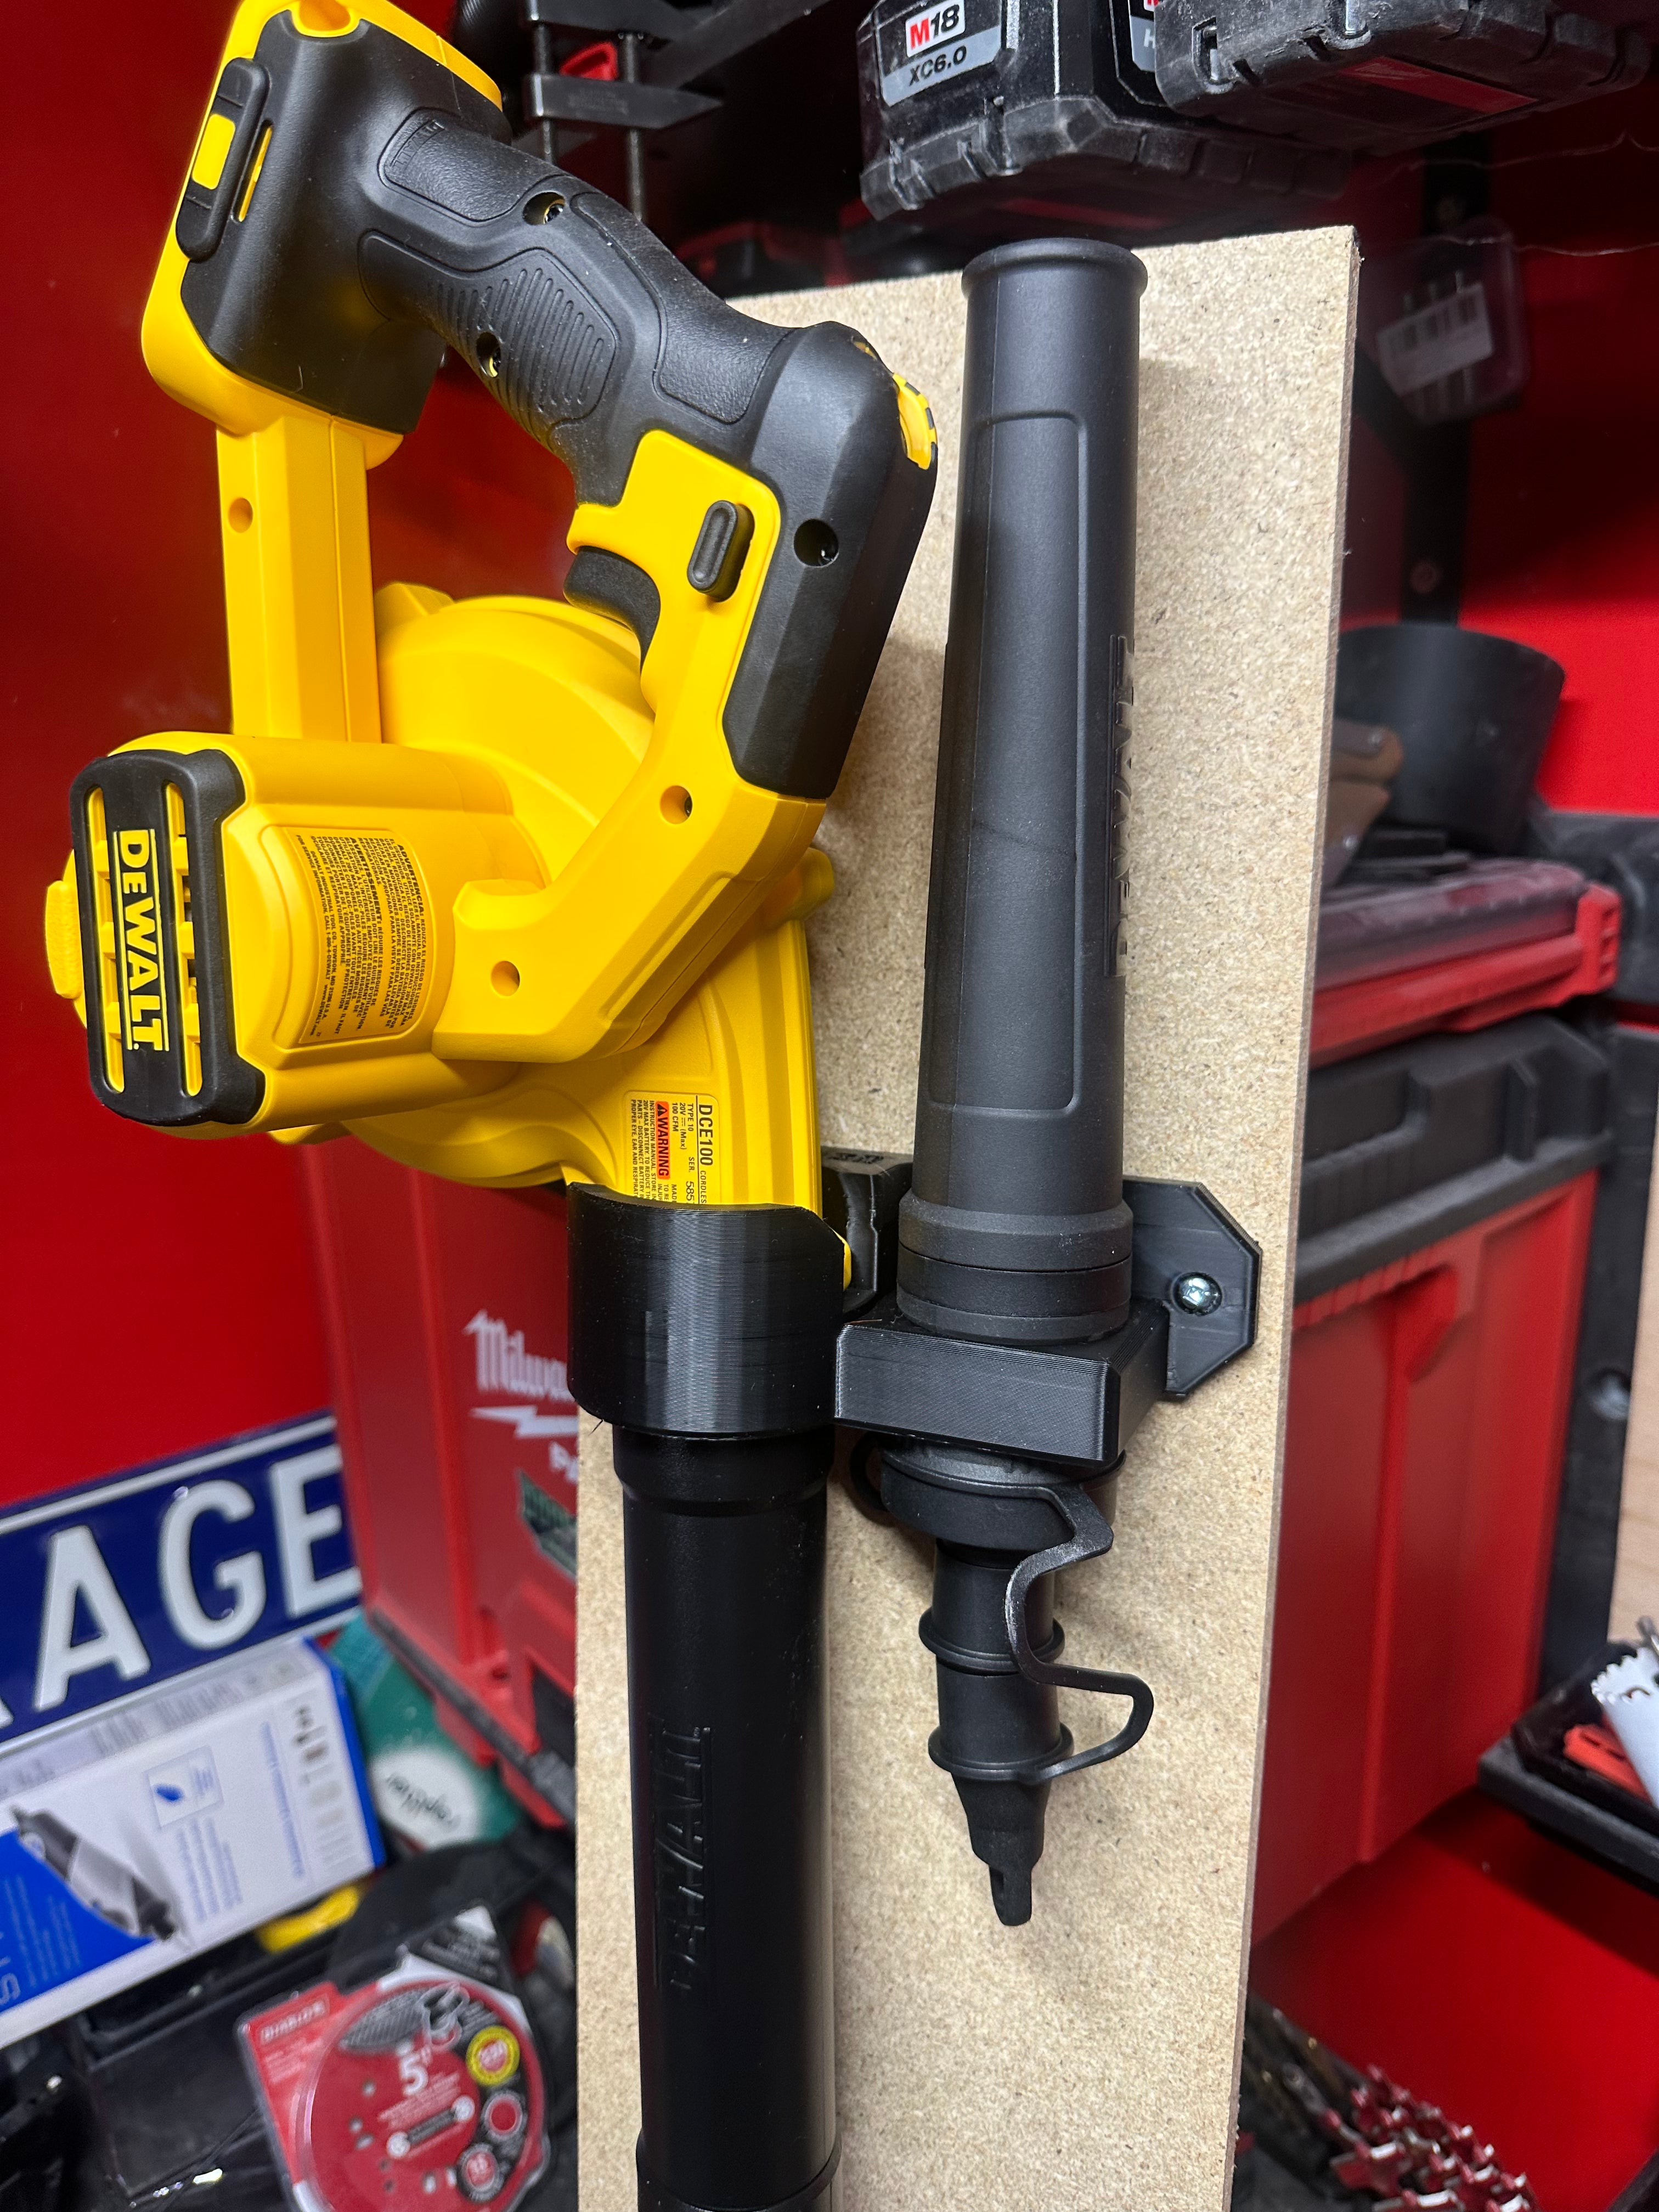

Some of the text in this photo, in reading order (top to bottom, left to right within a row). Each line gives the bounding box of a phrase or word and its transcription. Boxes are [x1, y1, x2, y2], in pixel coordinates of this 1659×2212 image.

[910, 4, 960, 50] M18
[909, 46, 966, 86] XC6.0
[296, 835, 306, 845] FOR
[302, 847, 316, 868] SERVICE
[317, 837, 335, 868] TOUJOURS
[323, 837, 346, 880] DÉCONNECTER
[339, 837, 359, 874] UTILISATION
[364, 838, 385, 874] PROTECCIÓN
[385, 839, 394, 850] USO
[403, 883, 412, 905] UTILICE
[393, 847, 408, 871] USUARIO
[311, 837, 329, 865] OCULAIRE
[329, 877, 343, 924] RESPIRATOIRE
[328, 837, 348, 872] DOMMAGES
[345, 874, 359, 912] CORPORELS
[332, 870, 344, 895] PORTER
[381, 877, 393, 914] APROPIADA
[392, 866, 404, 894] REDUZCA
[398, 845, 425, 916] ADVERTENCIA:
[311, 851, 324, 874] DEWALT
[321, 877, 334, 912] INDUSTRIAL
[330, 975, 336, 985] MD
[345, 891, 356, 929] BLOC-PILES
[350, 838, 382, 924] AVERTISSEMENT:
[373, 970, 382, 996] RISQUES
[362, 875, 376, 921] L'UTILISATEUR
[374, 839, 387, 858] PIEZAS
[389, 870, 403, 911] MOVIMIENTO
[396, 972, 405, 997] BATERÍA
[334, 837, 349, 860] DEWALT
[351, 874, 359, 889] MAX
[356, 977, 365, 1003] RISQUES
[343, 907, 351, 956] L'ÉQUIPEMENT
[369, 838, 385, 865] REALIZAR
[388, 985, 397, 1006] LLEVAR
[338, 969, 350, 1008] PROTECTION
[362, 963, 372, 1000] SEULEMENT
[395, 973, 409, 1015] OCASIONADAS
[334, 1020, 343, 1034] FAUT
[357, 1002, 365, 1017] AVEC
[380, 1004, 388, 1016] VÍAS
[658, 1117, 669, 1176] WARNING
[698, 1104, 713, 1165] DCE100
[686, 1181, 695, 1204] 585
[0, 1445, 362, 1726] AGE
